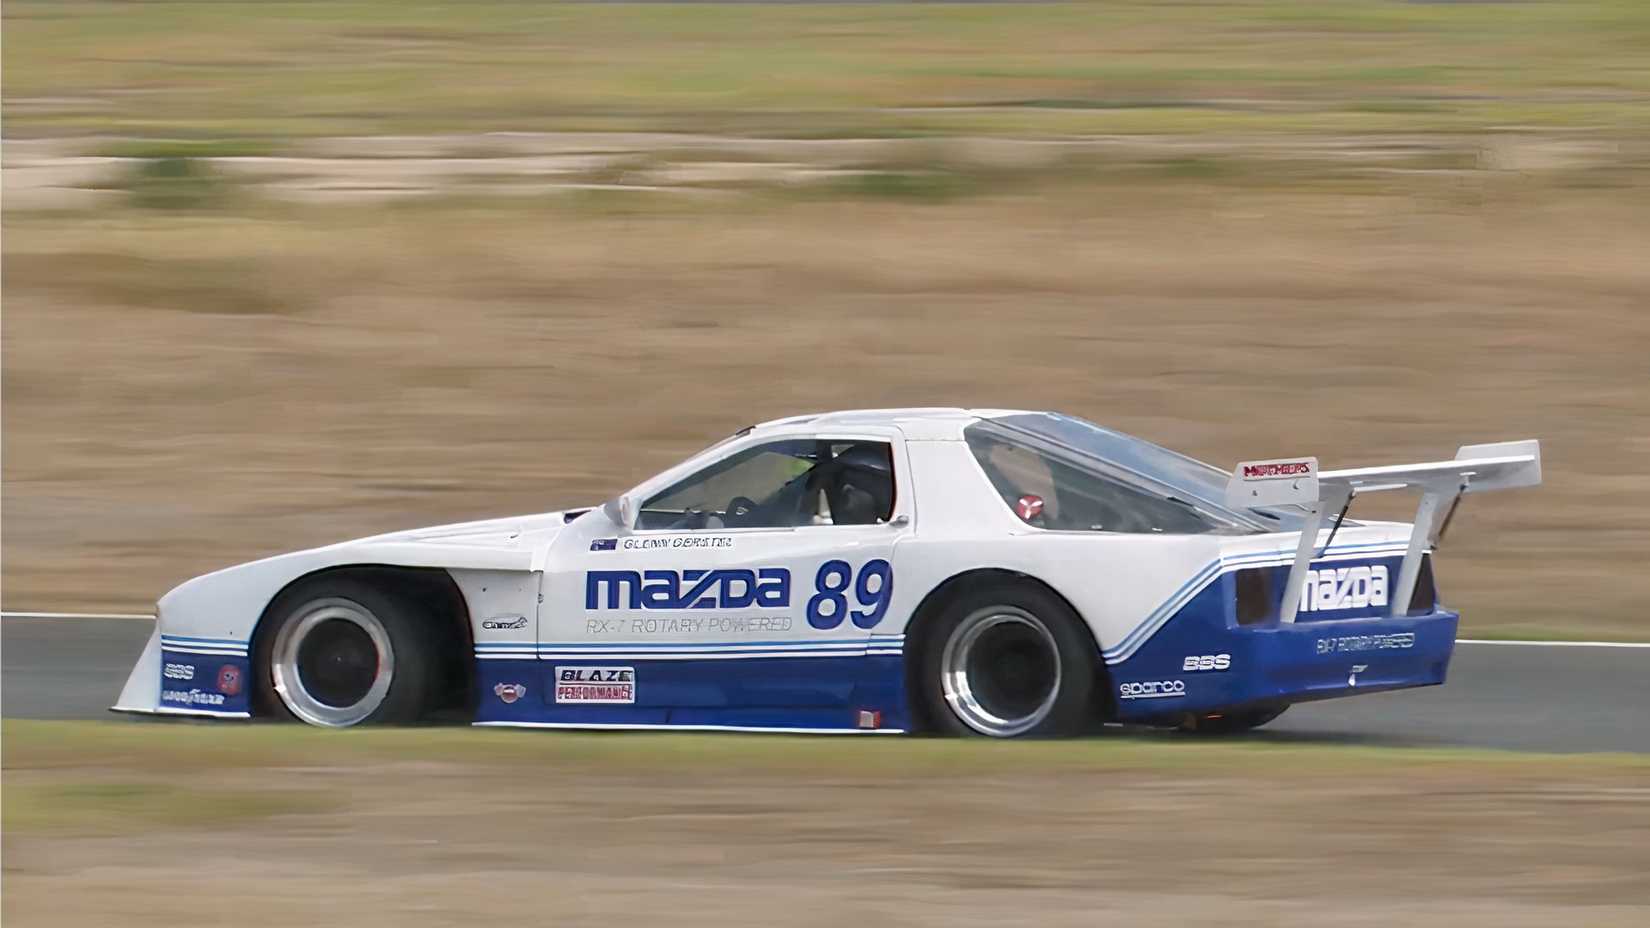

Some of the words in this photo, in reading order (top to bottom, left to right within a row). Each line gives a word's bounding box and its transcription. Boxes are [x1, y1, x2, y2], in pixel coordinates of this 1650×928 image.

[585, 567, 791, 609] mazda
[806, 558, 894, 630] 89
[631, 618, 703, 633] ROTARY
[708, 616, 793, 632] POWERED
[560, 669, 633, 682] BLAZE
